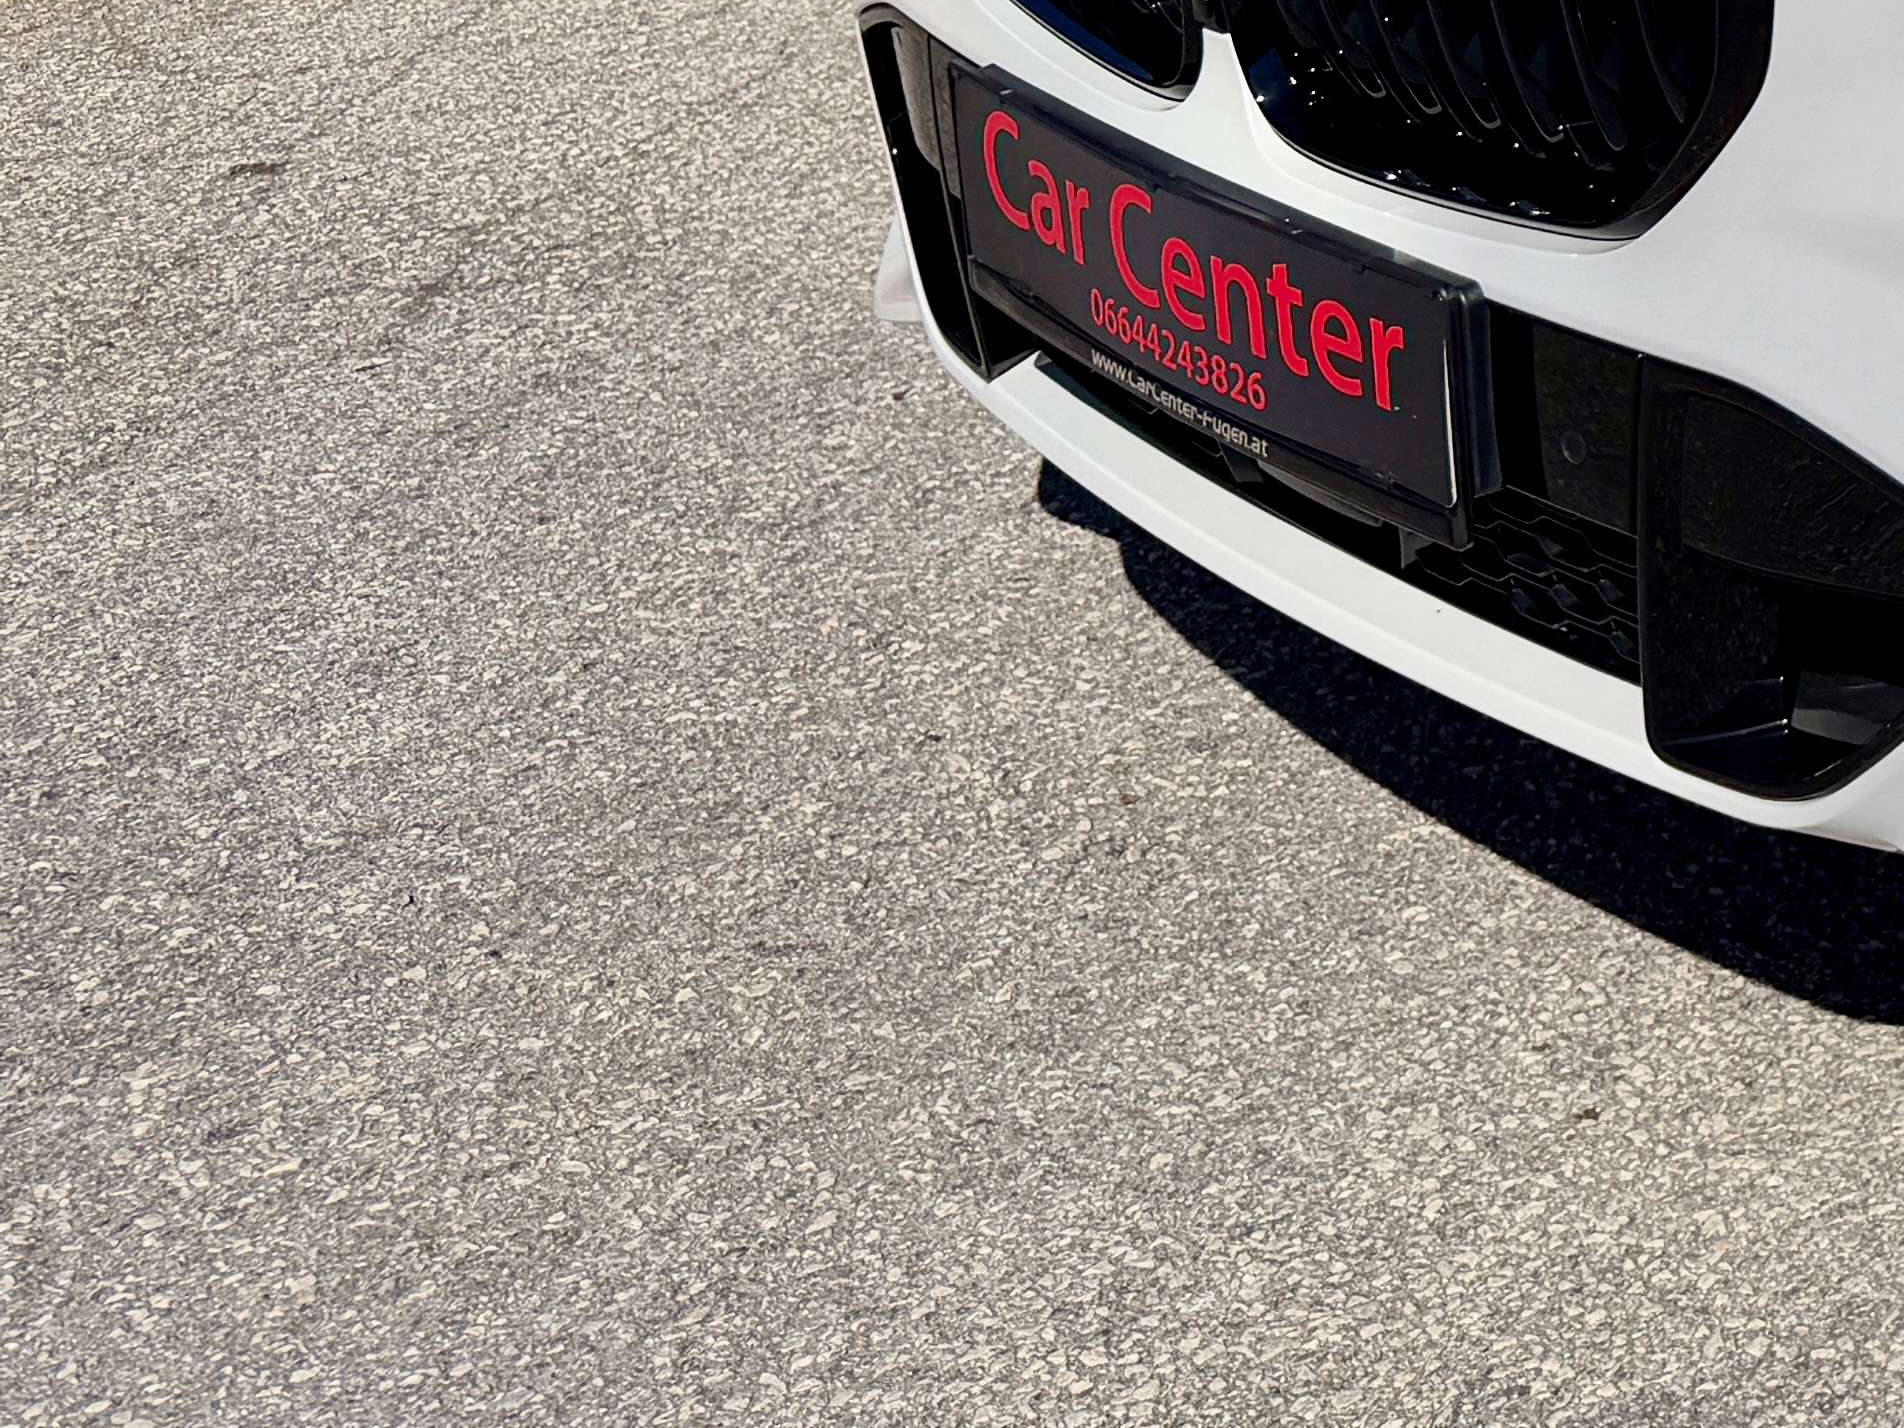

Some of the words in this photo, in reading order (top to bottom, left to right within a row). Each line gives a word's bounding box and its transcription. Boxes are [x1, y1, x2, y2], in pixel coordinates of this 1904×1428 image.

[983, 110, 1090, 265] Car
[1109, 184, 1405, 411] Center
[1090, 287, 1268, 412] 06644243826
